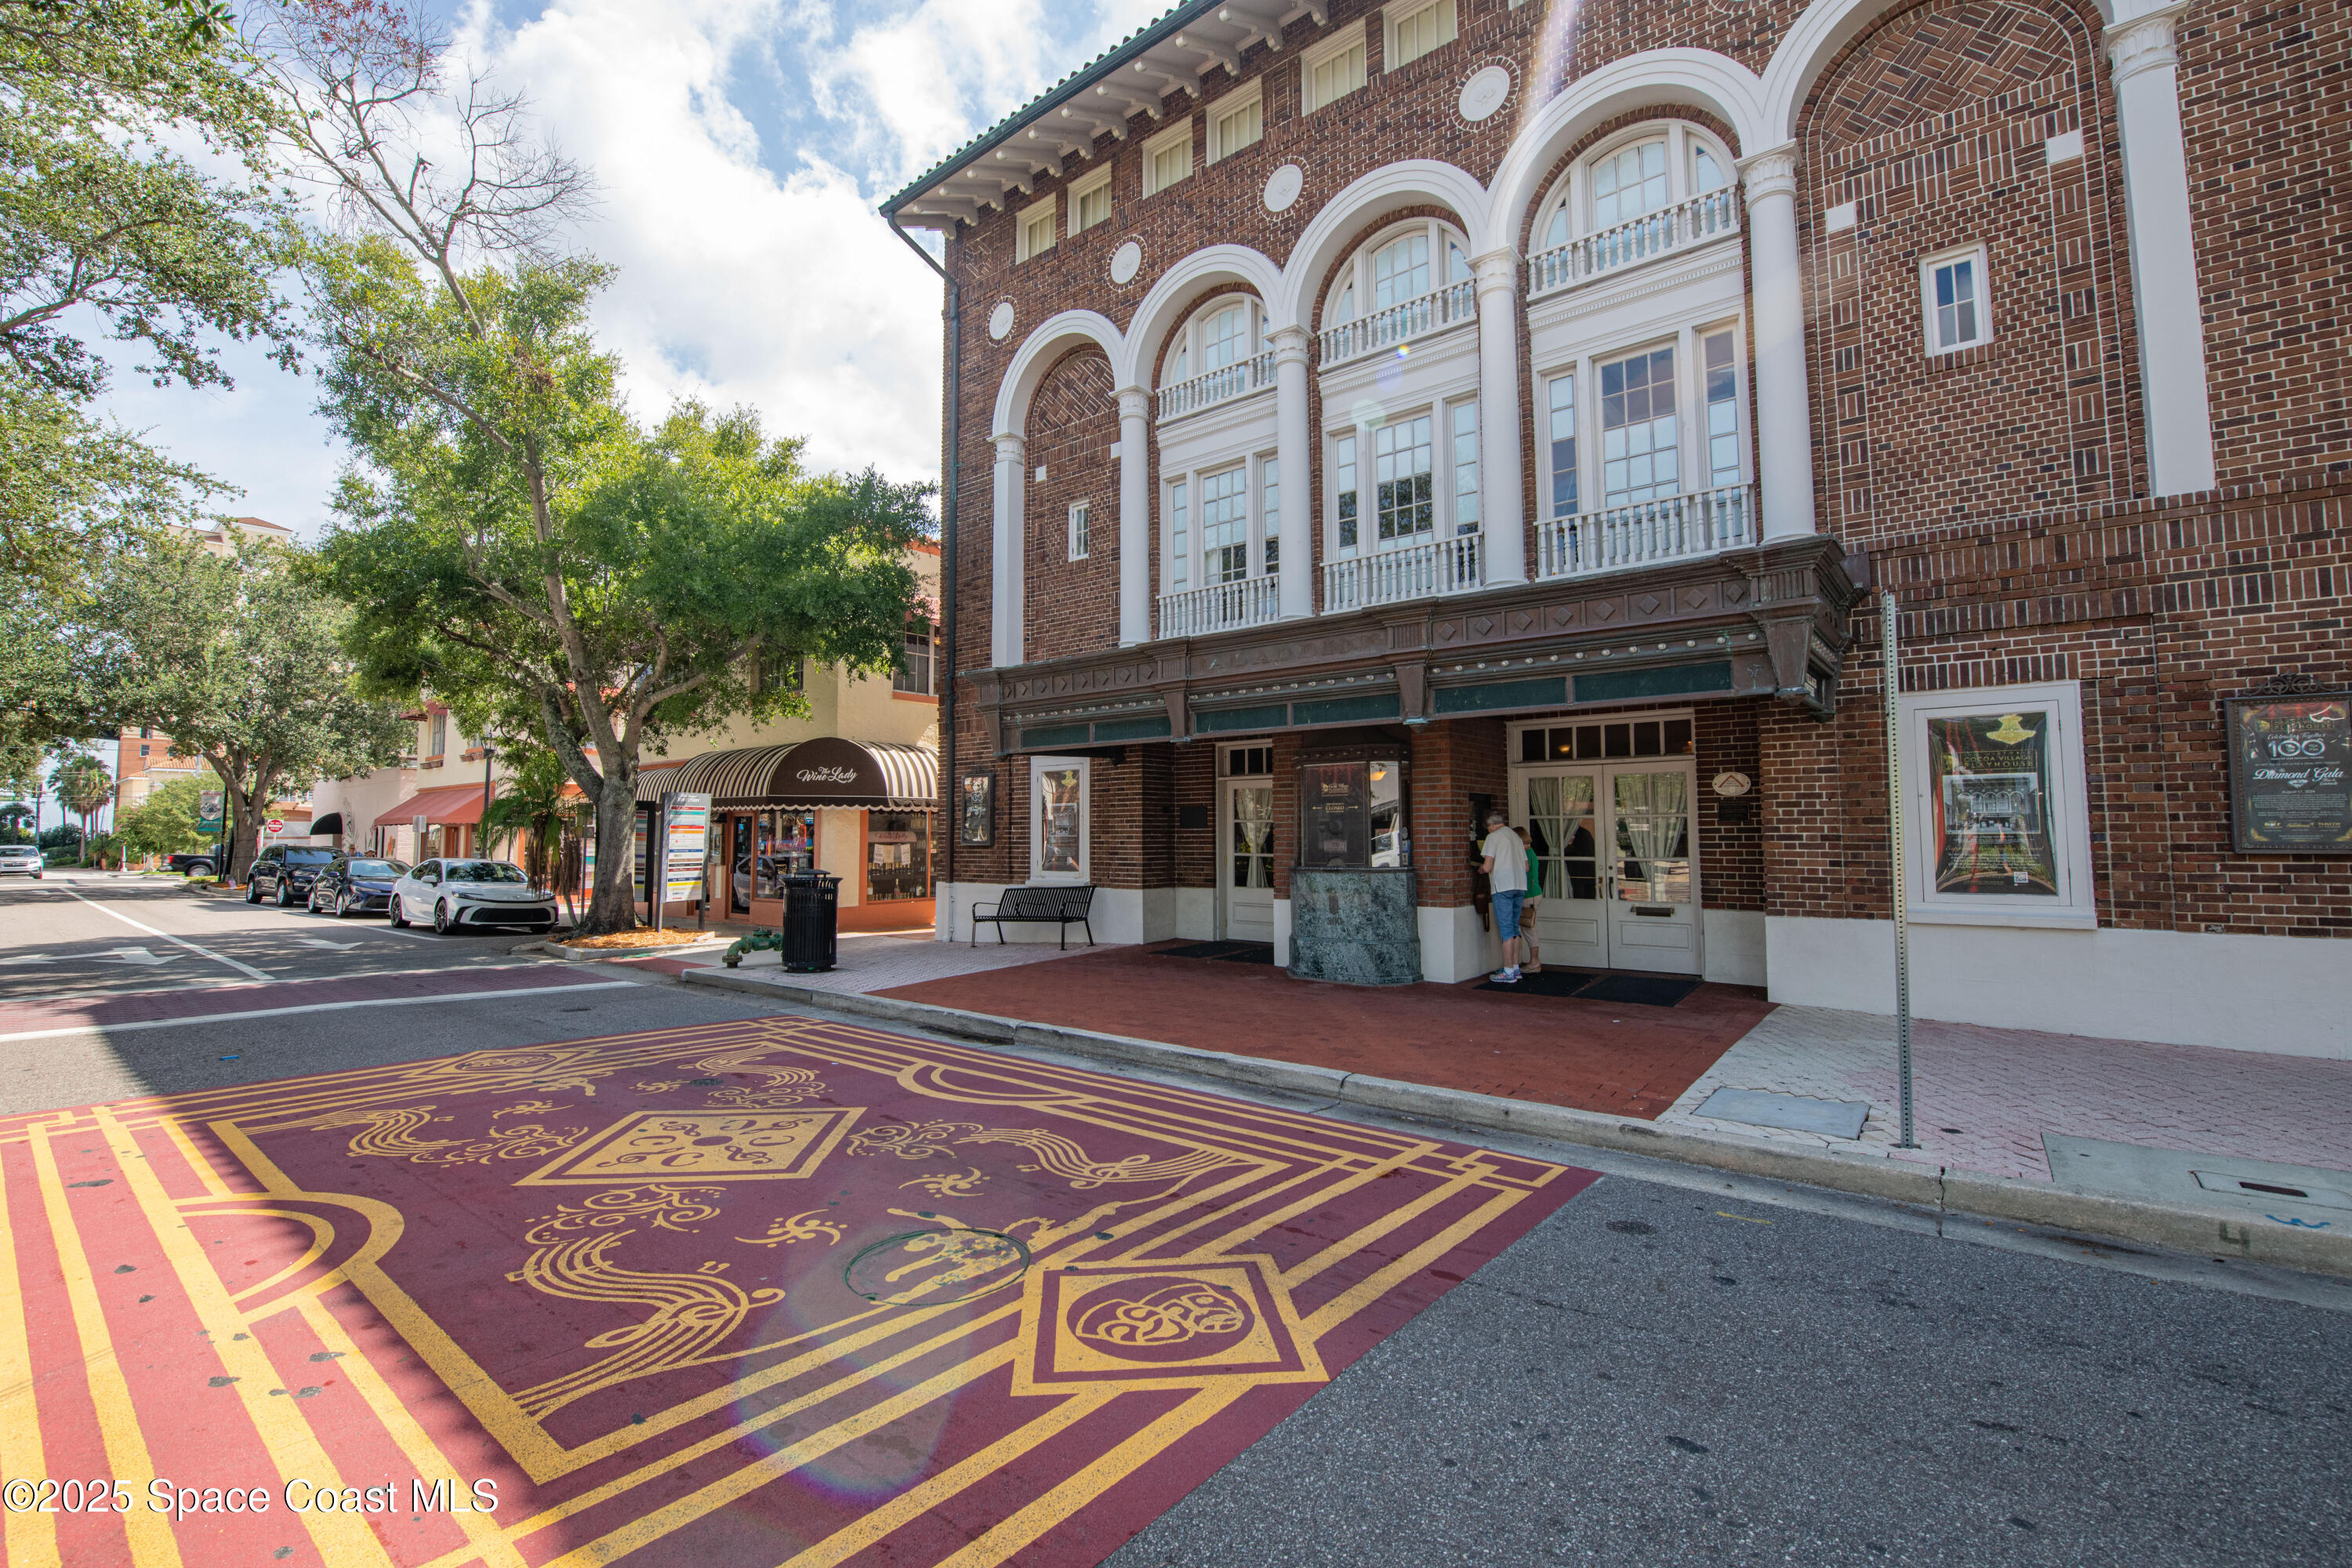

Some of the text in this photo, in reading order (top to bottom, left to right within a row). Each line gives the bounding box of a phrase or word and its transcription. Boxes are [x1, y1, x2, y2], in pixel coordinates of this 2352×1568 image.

[2268, 739, 2325, 757] 100
[797, 767, 858, 783] Wine Lady
[818, 766, 831, 775] The
[2252, 767, 2344, 782] Diamond Gala
